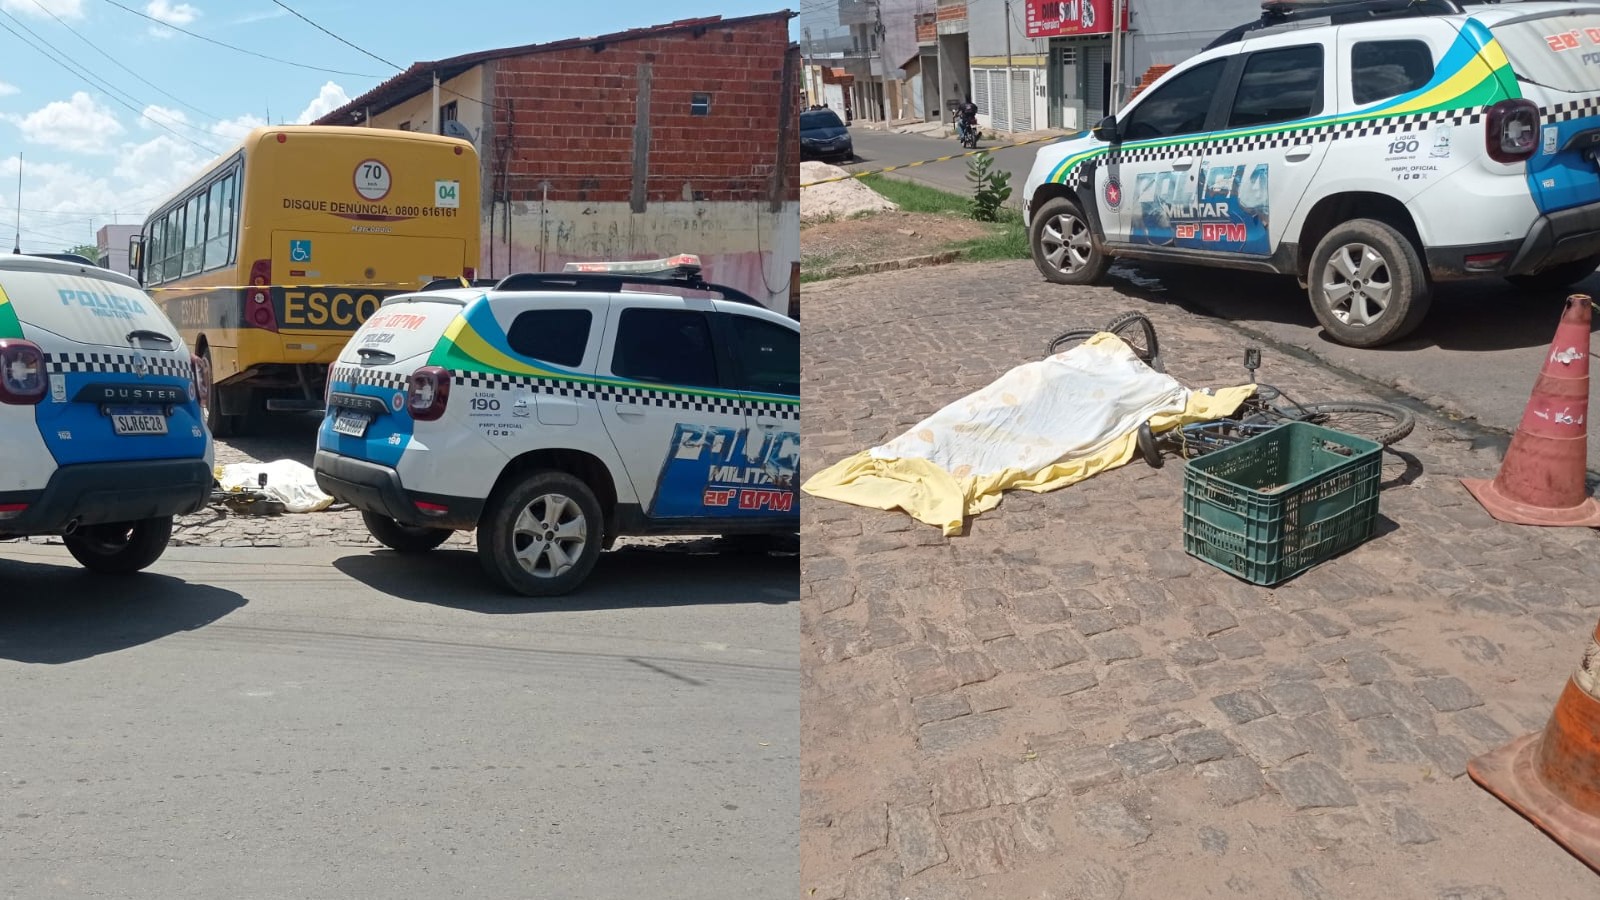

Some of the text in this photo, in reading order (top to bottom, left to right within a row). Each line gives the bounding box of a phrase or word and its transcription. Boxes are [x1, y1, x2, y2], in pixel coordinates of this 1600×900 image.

[1388, 140, 1419, 154] 190
[363, 164, 382, 179] 70
[439, 185, 456, 200] 04
[283, 199, 457, 217] DISQUE DENÚNCIA: 0800 616161
[1164, 202, 1229, 218] MILITAR
[1202, 223, 1246, 242] BPM
[181, 297, 209, 325] ESCOLAR
[285, 292, 380, 325] ESCO
[104, 389, 176, 399] DUSTER
[470, 398, 500, 410] 190
[118, 415, 164, 432] SLR6E28
[709, 465, 792, 486] MILITAR
[739, 489, 793, 511] BPM
